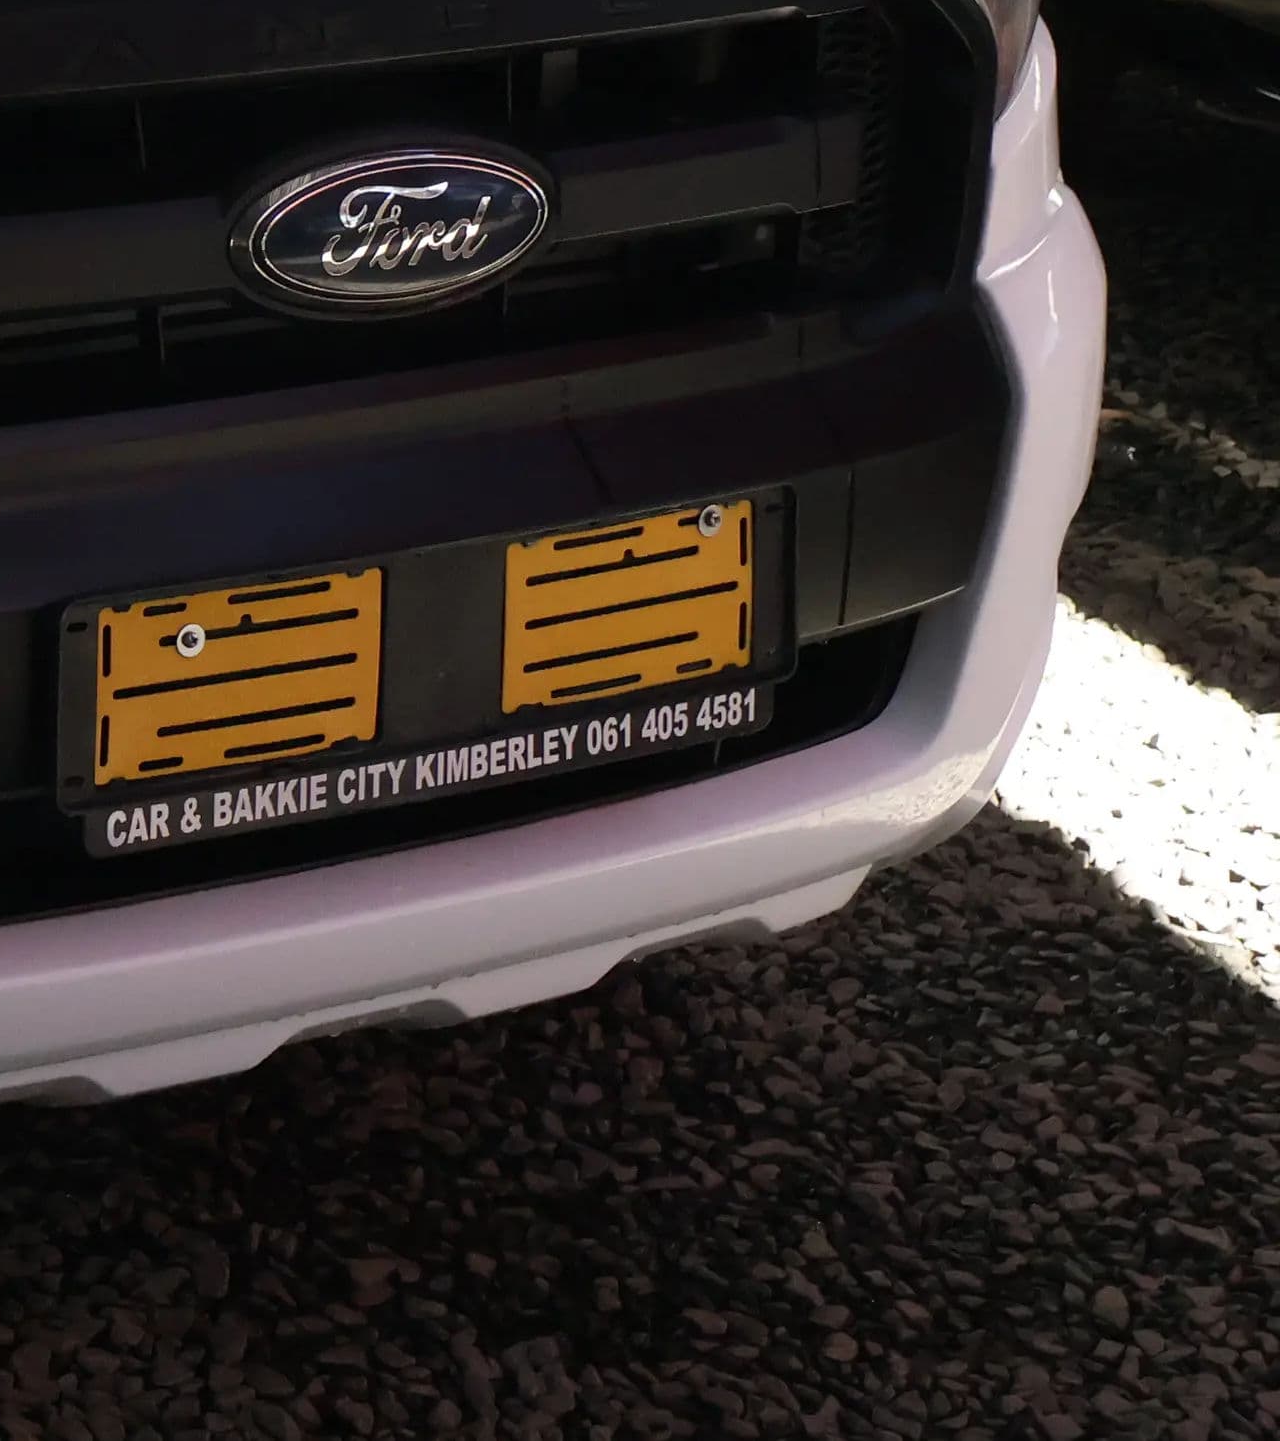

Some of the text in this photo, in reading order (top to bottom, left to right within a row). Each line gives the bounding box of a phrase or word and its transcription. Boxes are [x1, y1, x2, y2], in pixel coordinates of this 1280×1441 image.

[321, 180, 492, 277] Ford
[106, 687, 757, 848] CAR & BAKKIE CITY KIMBERLEY 061 405 4581
